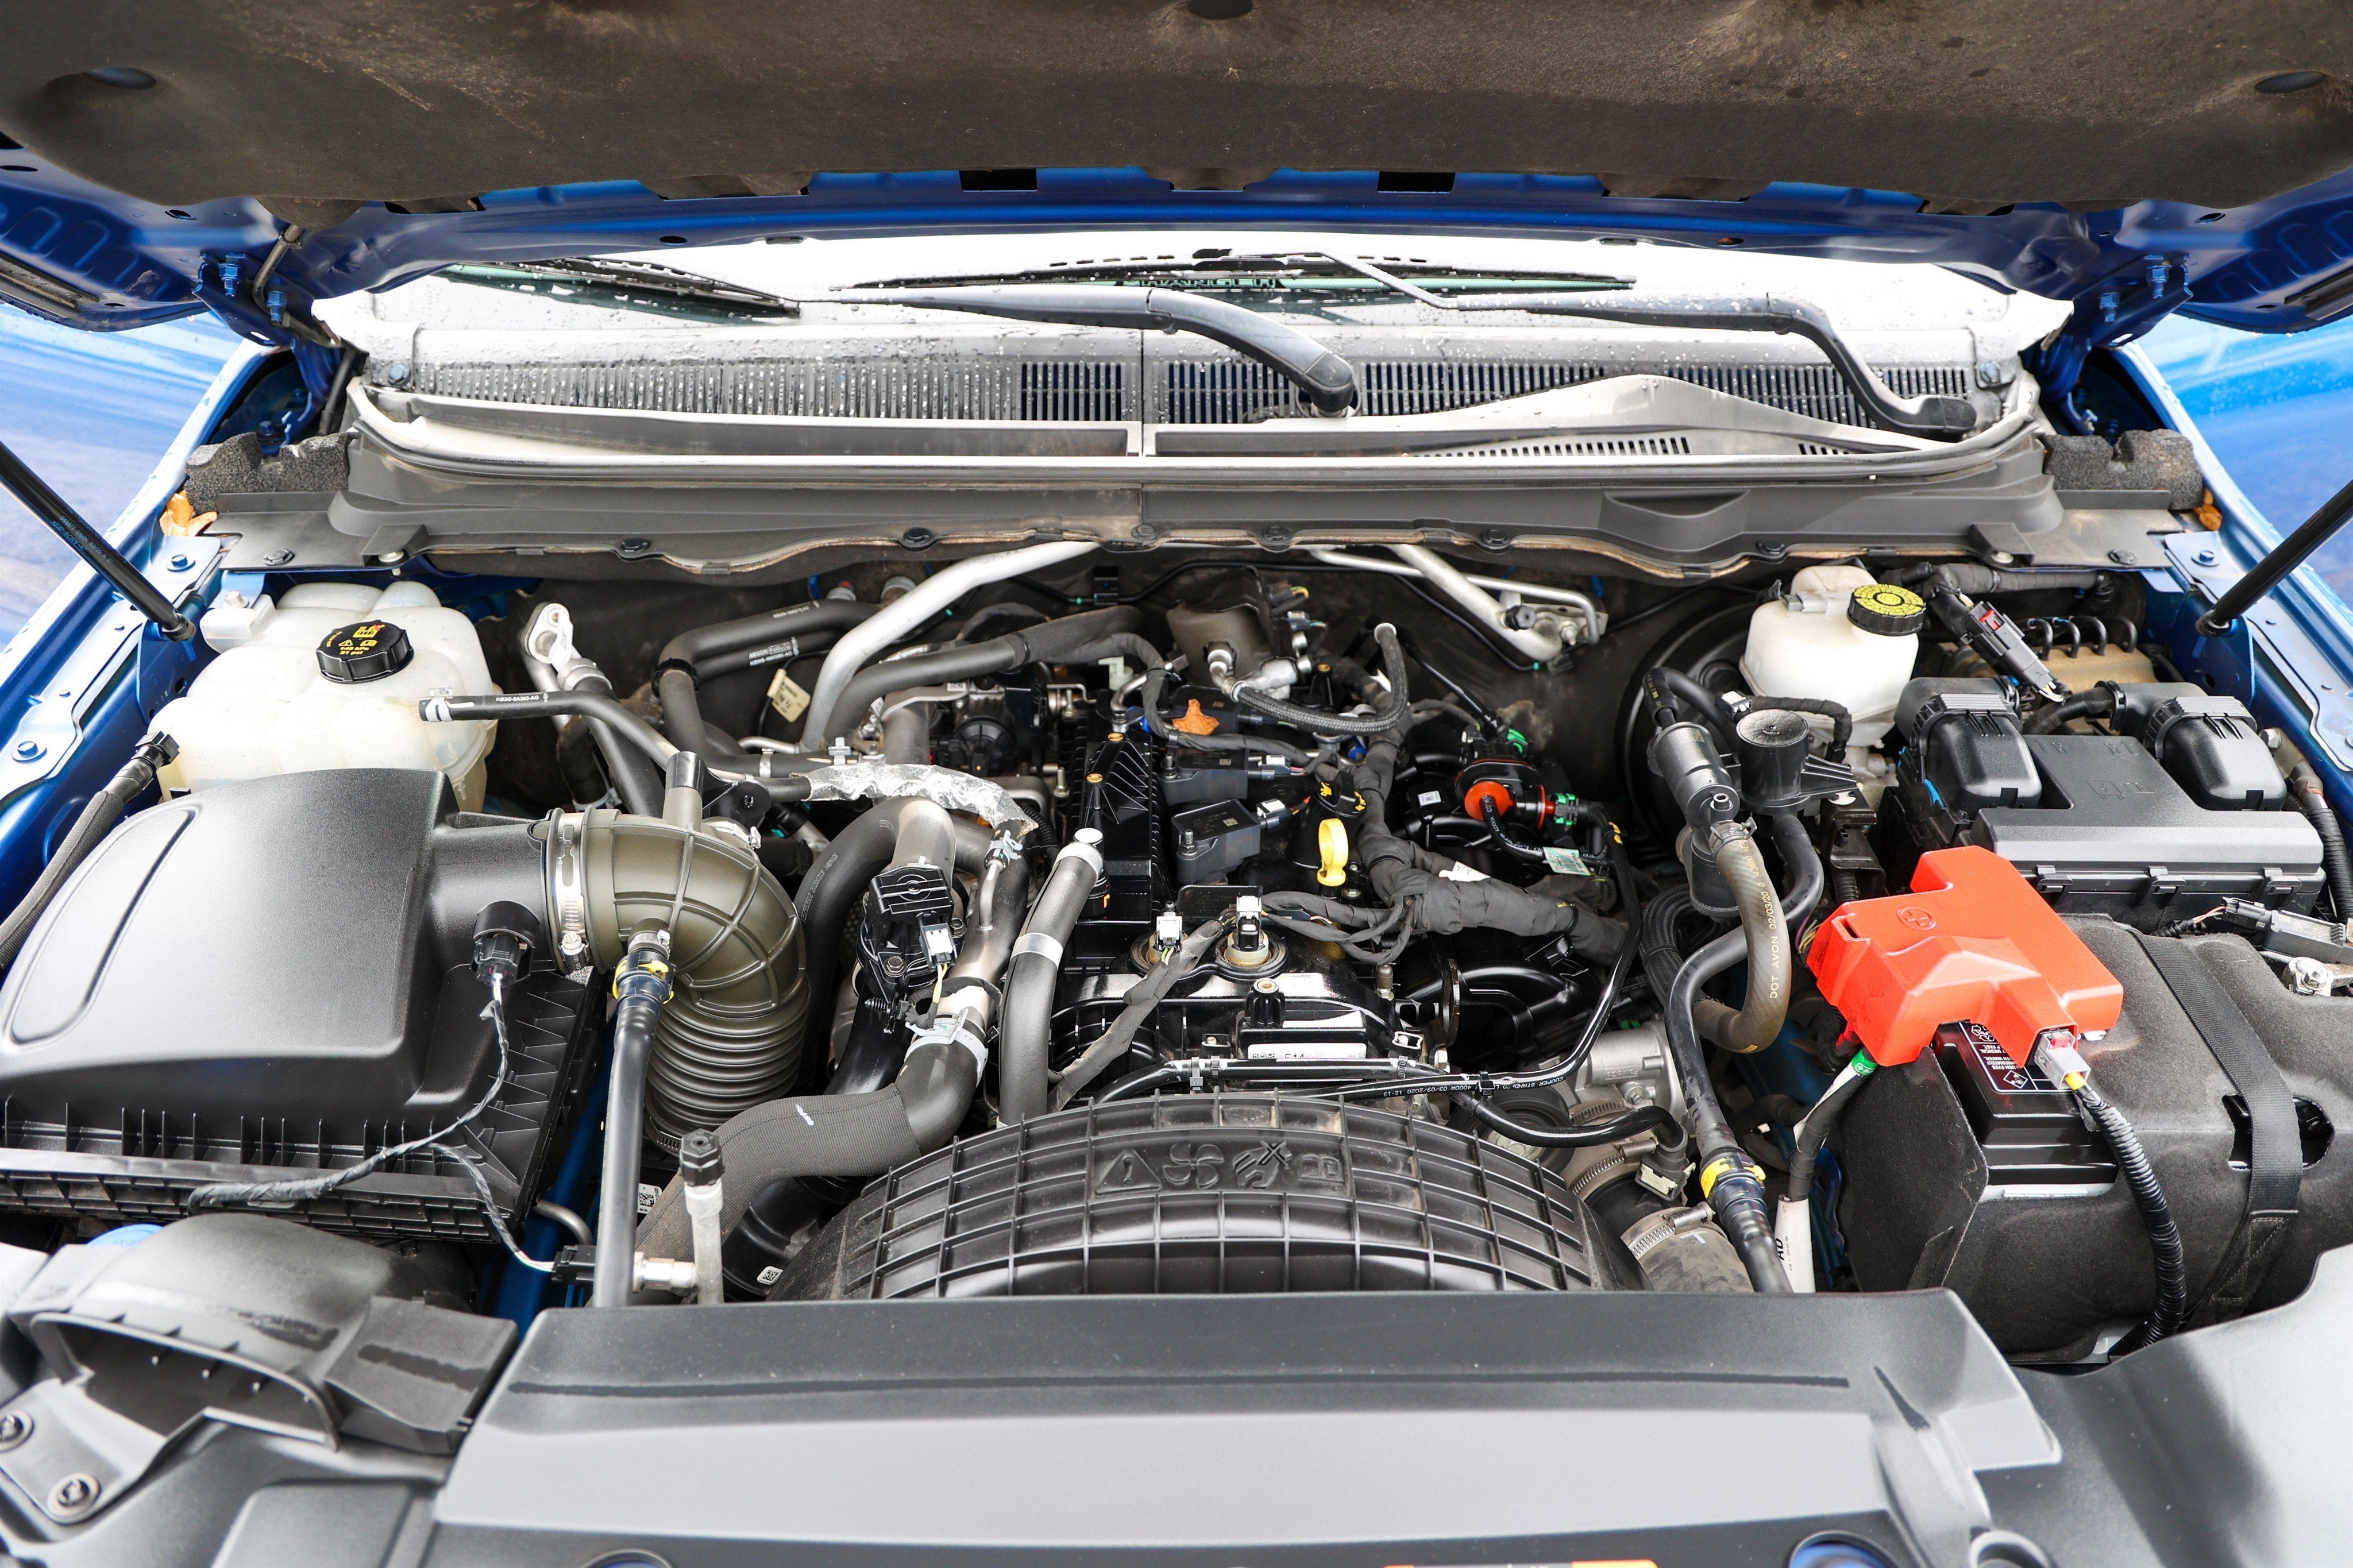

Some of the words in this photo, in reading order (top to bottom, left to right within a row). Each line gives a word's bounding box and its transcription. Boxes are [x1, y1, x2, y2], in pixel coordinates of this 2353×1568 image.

[1761, 891, 1777, 929] 02/03/20
[1772, 936, 1780, 969] AVON
[1770, 977, 1780, 999] DOT
[1407, 1086, 1448, 1095] 03/09/2020
[1538, 1076, 1564, 1087] COOPER
